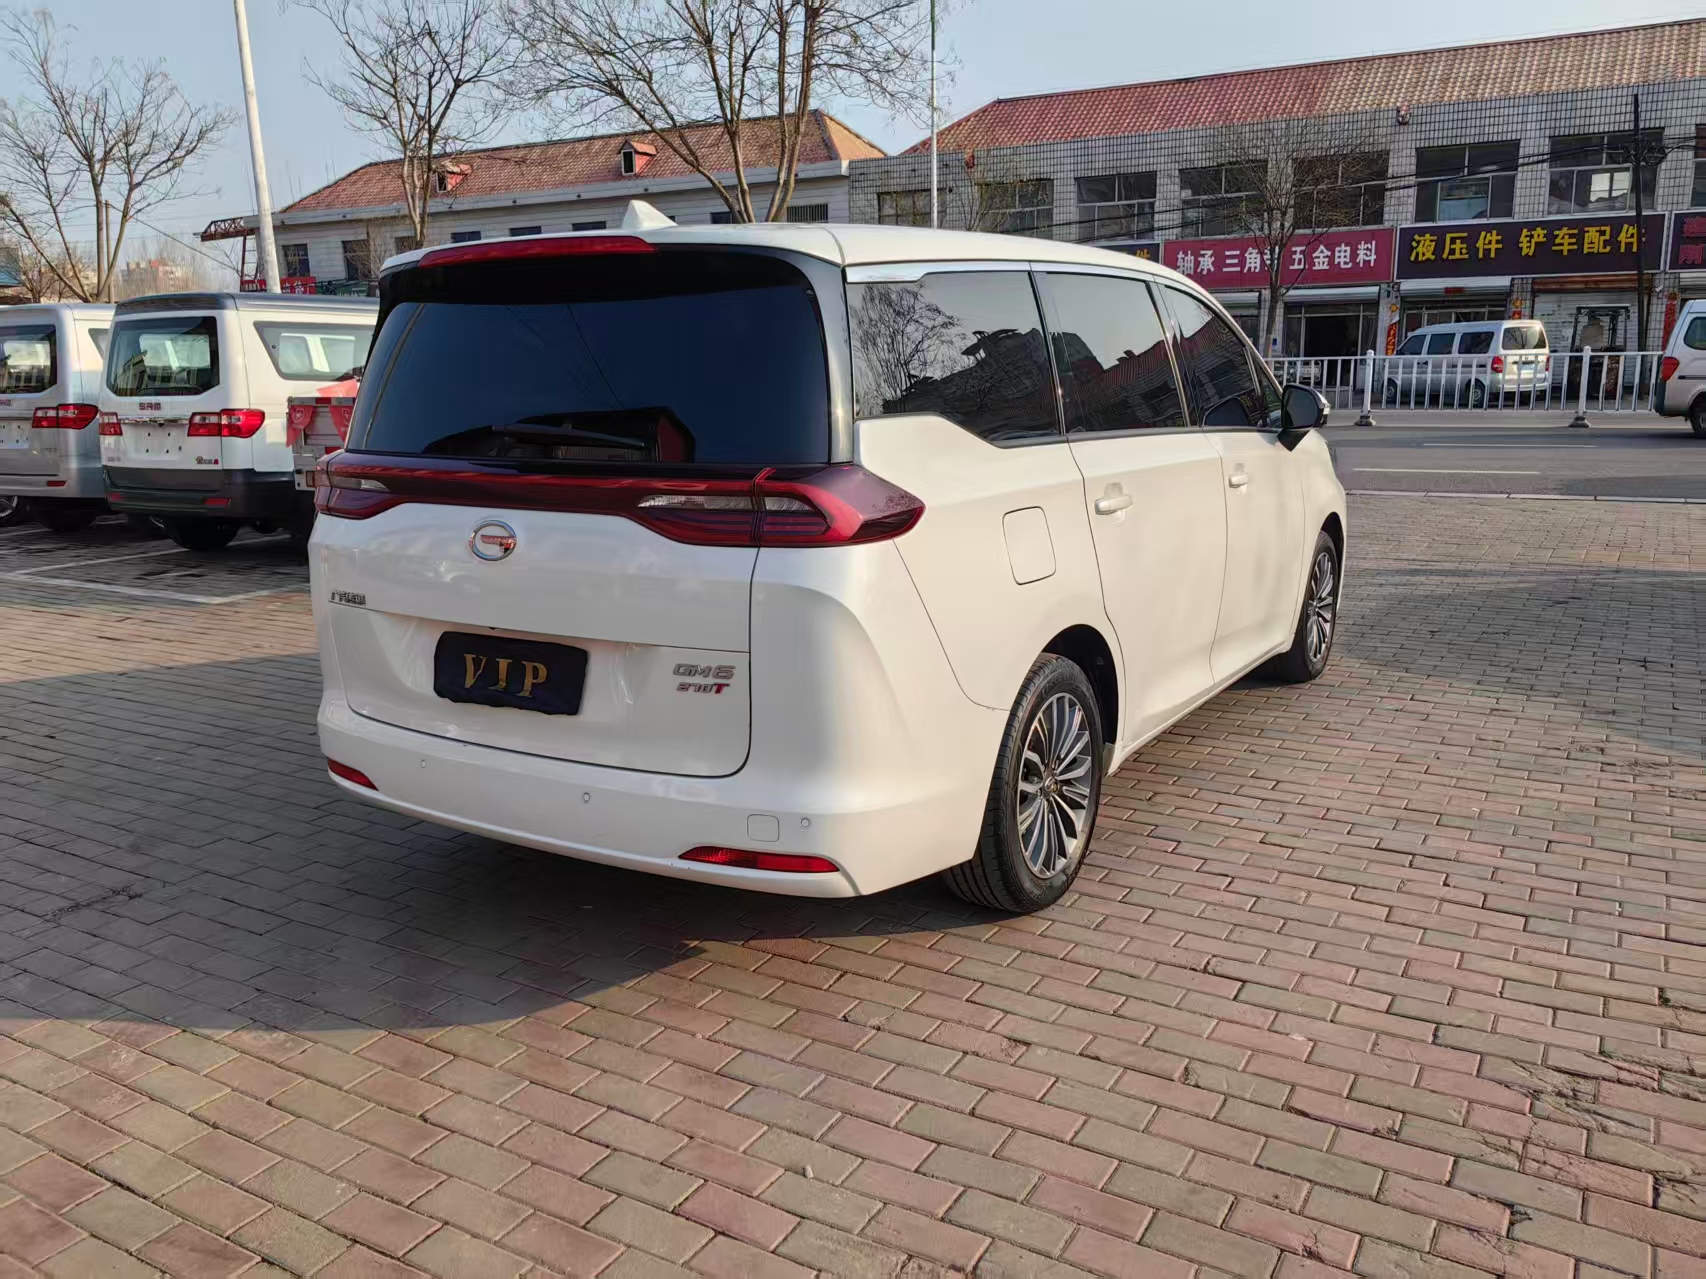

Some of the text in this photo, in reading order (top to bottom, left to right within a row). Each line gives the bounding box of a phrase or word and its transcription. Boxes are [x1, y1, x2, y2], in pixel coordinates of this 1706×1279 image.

[1176, 250, 1215, 275] 轴承
[1289, 240, 1377, 270] 五金电料
[1410, 229, 1503, 261] 液压件
[1519, 224, 1646, 256] 铲车配件
[464, 653, 548, 697] VIP
[673, 663, 736, 680] GM6
[676, 682, 731, 694] 270T
